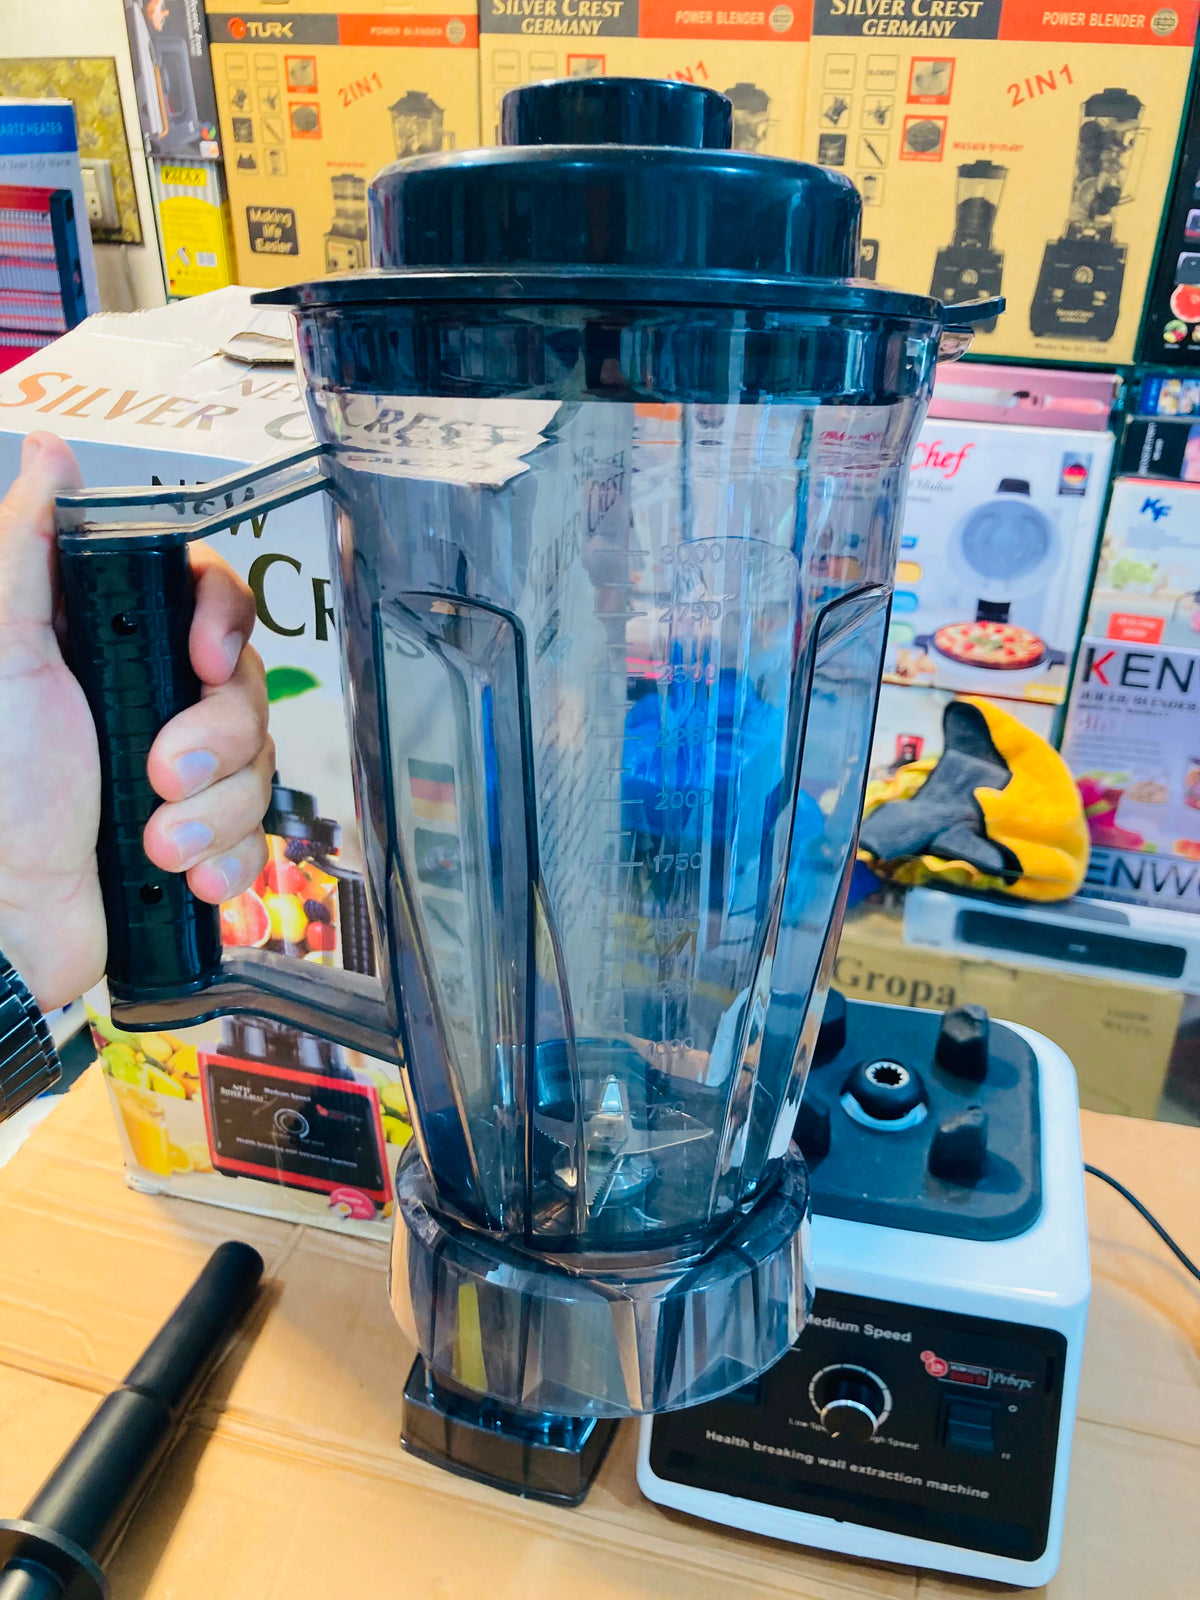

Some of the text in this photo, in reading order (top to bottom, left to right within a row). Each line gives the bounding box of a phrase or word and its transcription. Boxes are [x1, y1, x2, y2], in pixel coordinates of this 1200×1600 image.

[491, 0, 624, 17] SILVER CREST
[675, 10, 713, 24] POWER
[716, 11, 765, 25] BLENDER
[830, 0, 984, 17] SILVER CREST
[521, 18, 603, 35] GERMANY
[862, 19, 957, 37] GERMANY
[1042, 11, 1086, 26] POWER
[1089, 13, 1146, 28] BLENDER
[247, 21, 294, 38] TURK
[0, 371, 240, 431] SILVER
[1081, 647, 1196, 693] KEN
[654, 787, 713, 811] 2000
[653, 852, 704, 874] 1750
[1084, 850, 1200, 896] ENW
[863, 1323, 913, 1343] Speed
[705, 1429, 991, 1500] Health breaking wall extraction machine
